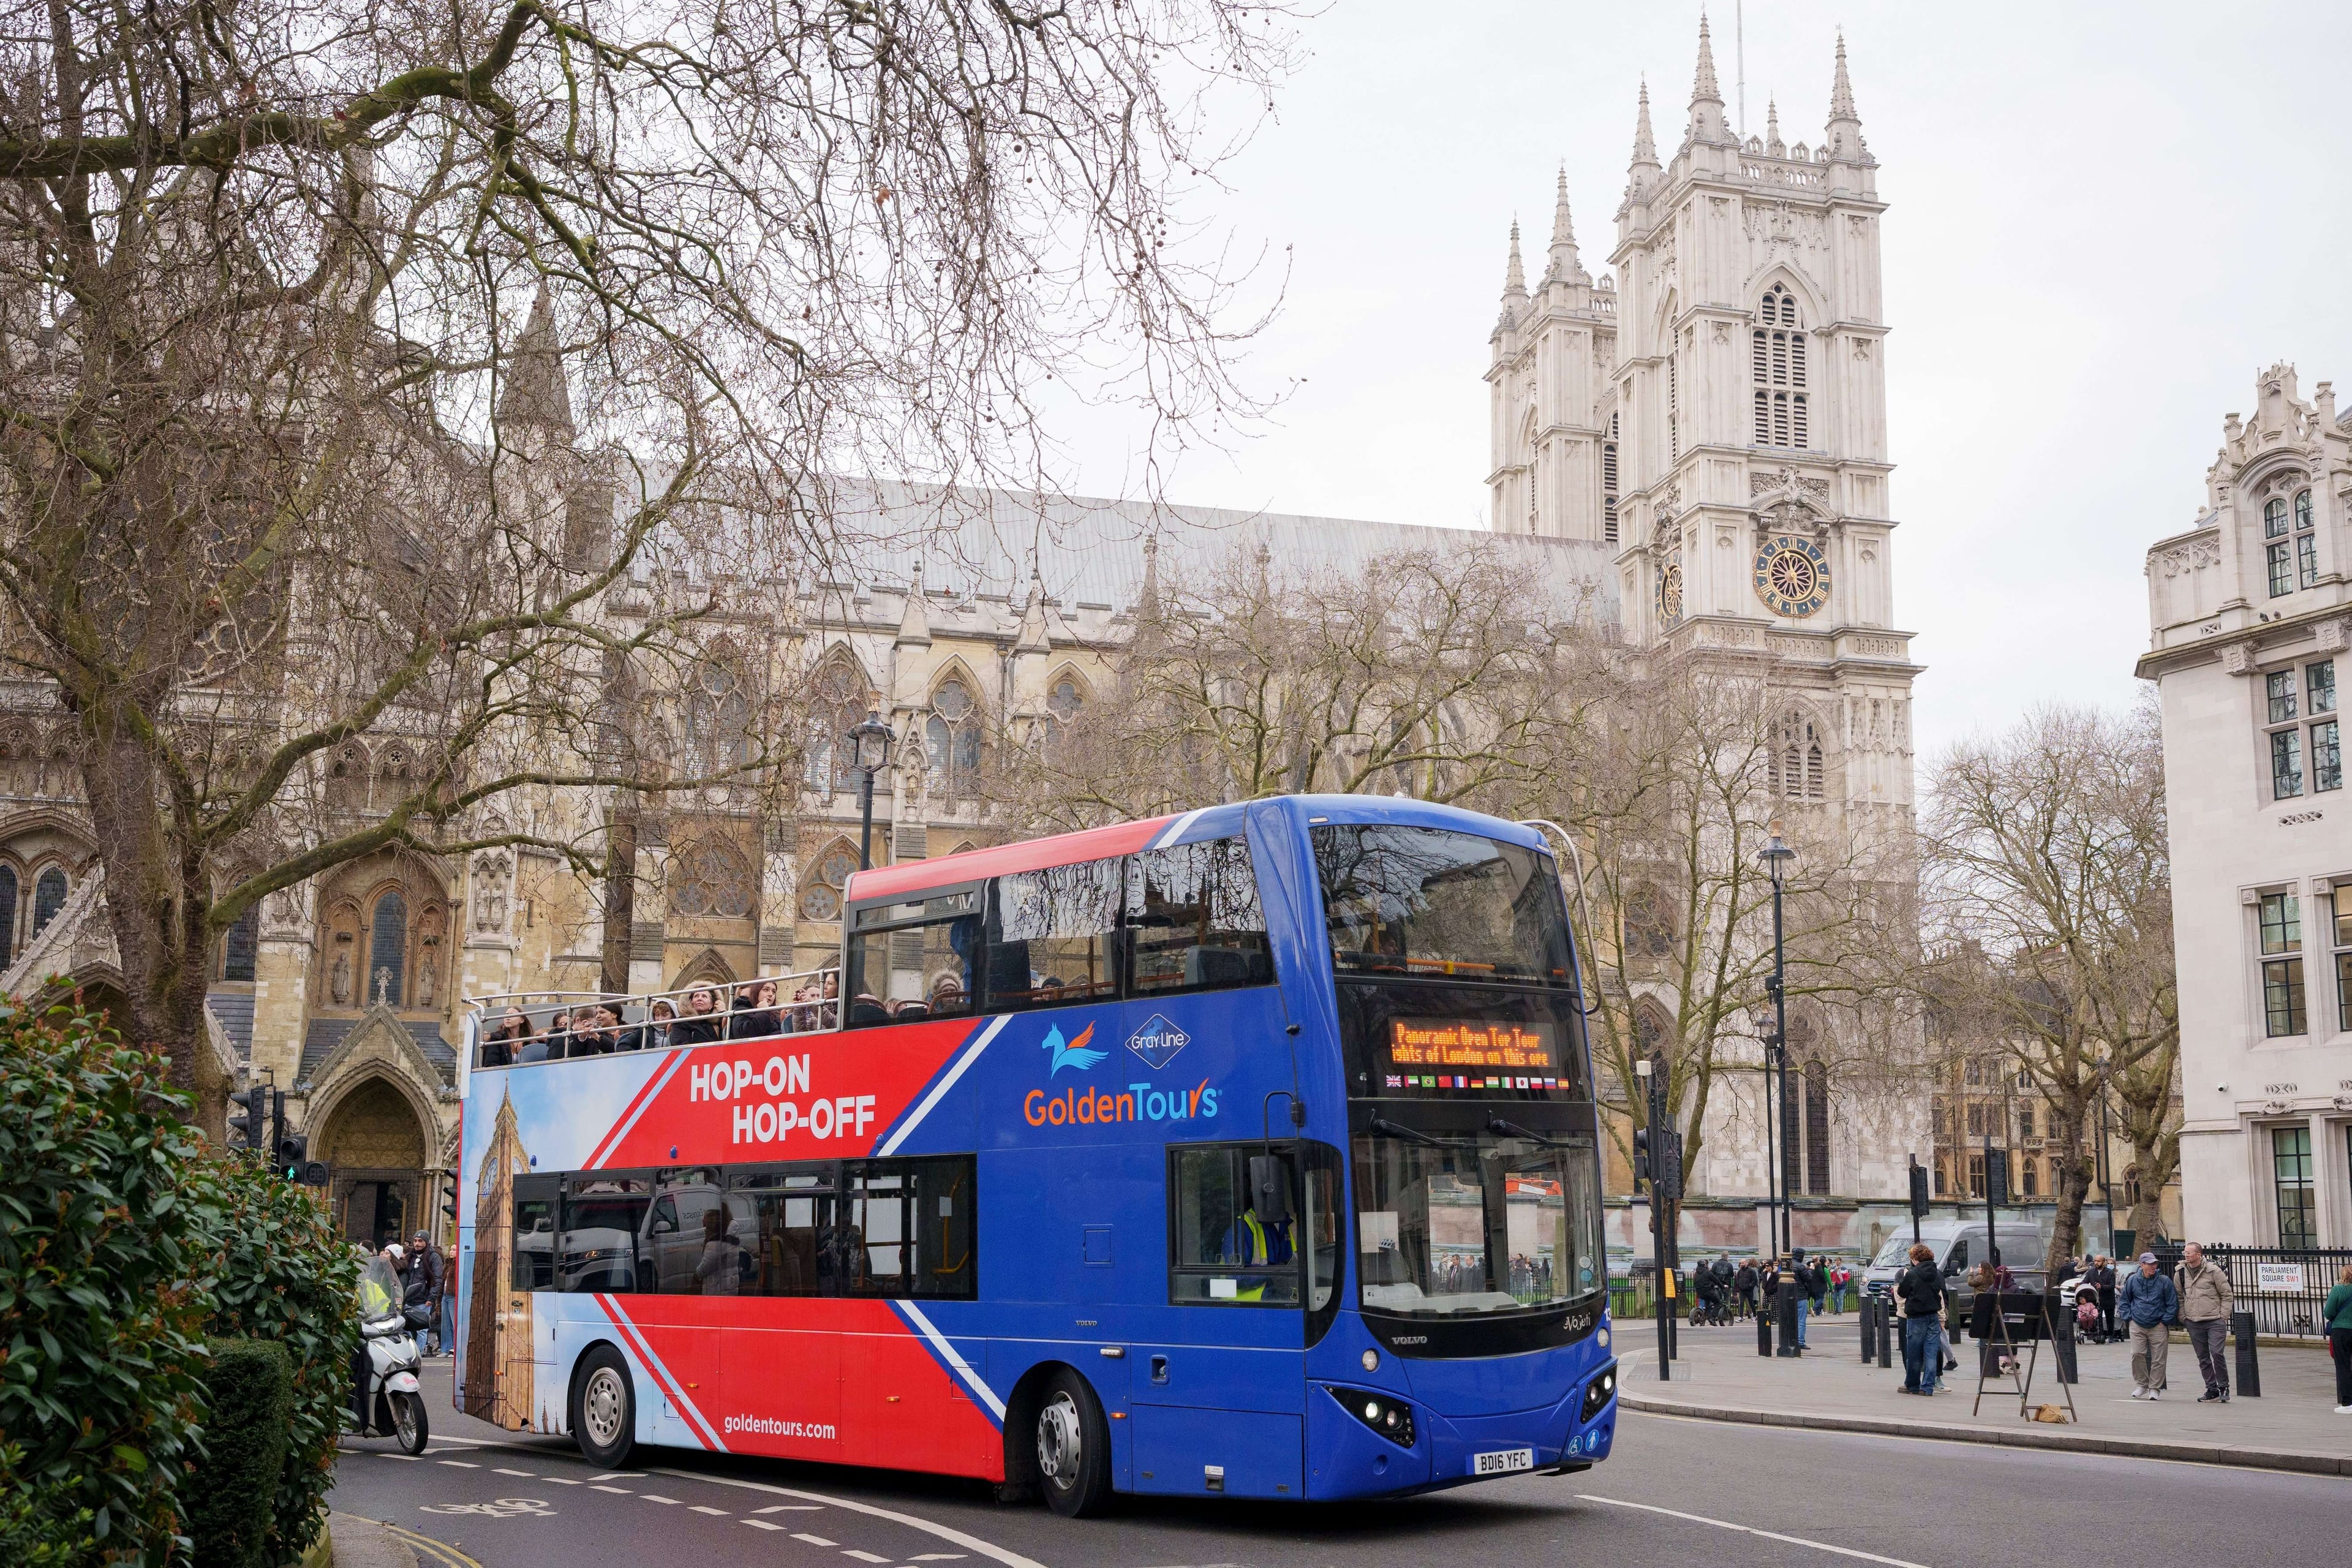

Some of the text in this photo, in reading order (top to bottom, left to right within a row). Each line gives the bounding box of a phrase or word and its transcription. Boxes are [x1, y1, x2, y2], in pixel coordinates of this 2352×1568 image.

[1396, 1023, 1540, 1048] Panoramic Open Top Tour
[1426, 1046, 1439, 1062] of
[1442, 1046, 1484, 1064] London
[1487, 1052, 1501, 1064] on
[1504, 1048, 1526, 1065] this
[690, 1054, 810, 1102] HOP-ON
[733, 1095, 876, 1144] HOP-OFF
[1604, 1307, 1611, 1322] 13
[1391, 1336, 1428, 1345] VOLVO
[725, 1413, 835, 1440] goldentours.com
[1480, 1452, 1526, 1471] BD16 YFC
